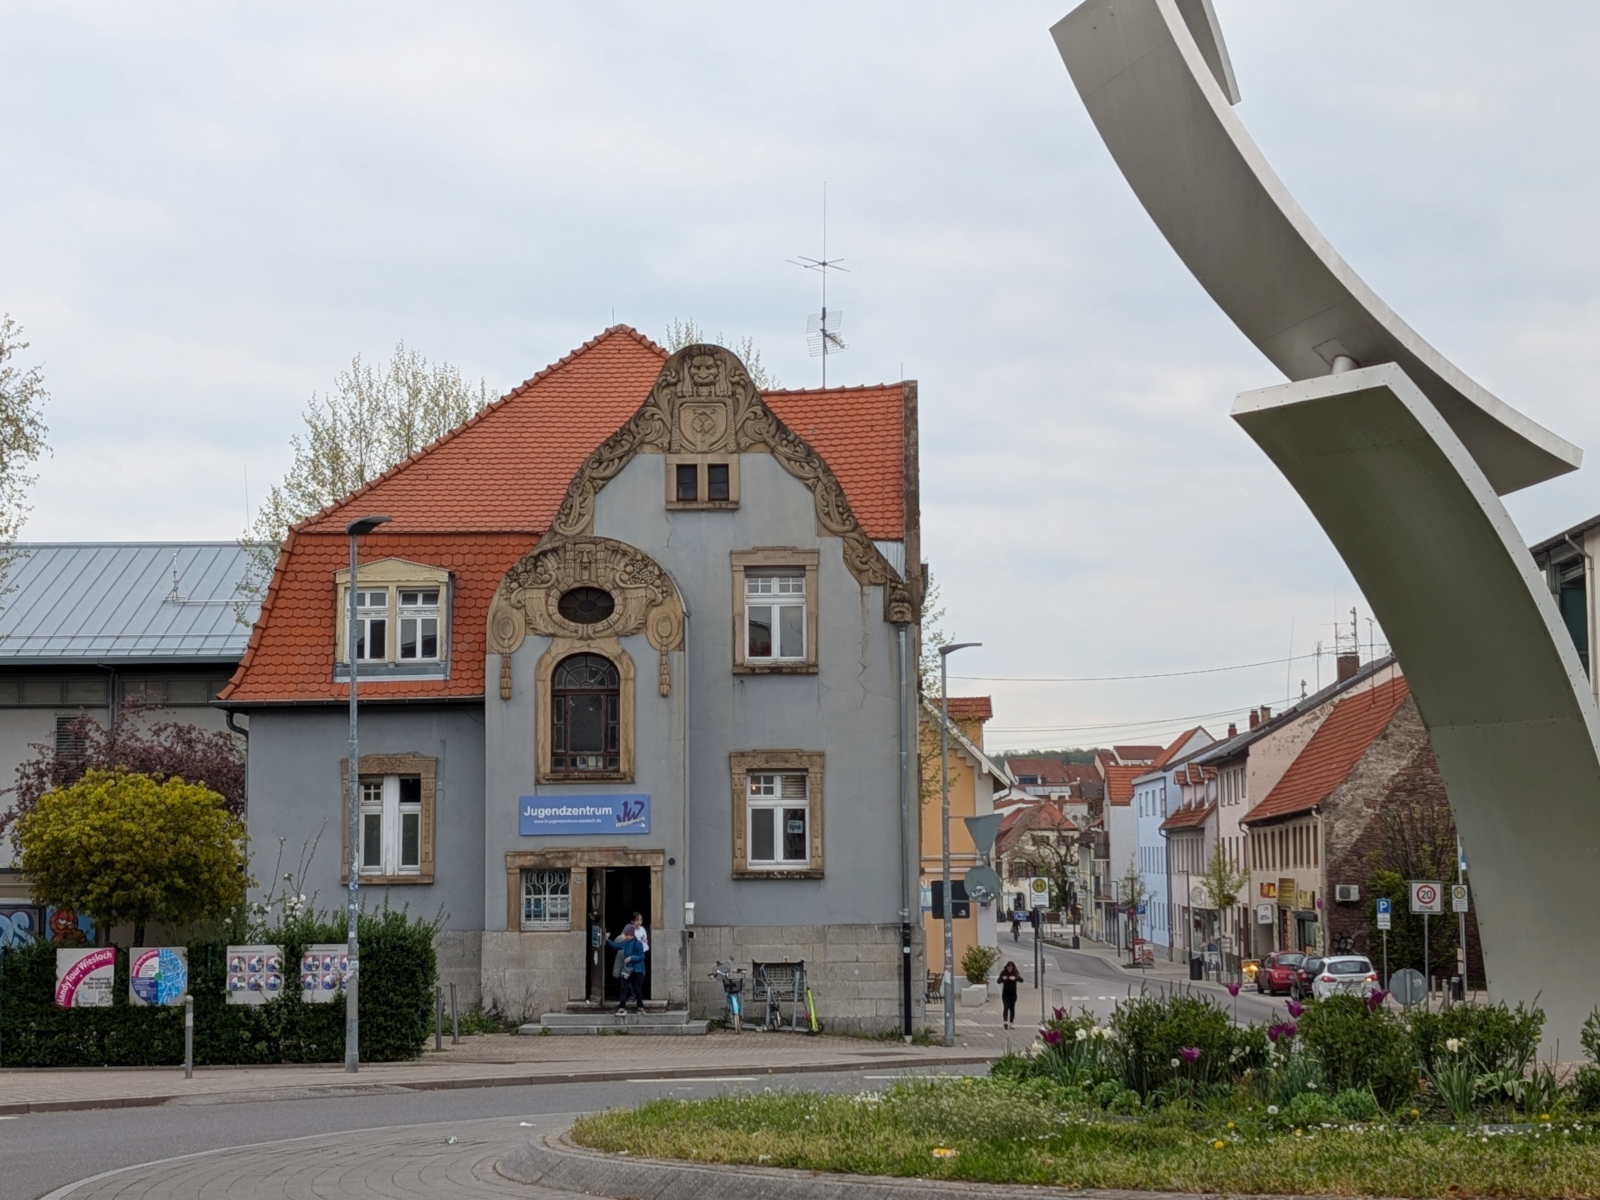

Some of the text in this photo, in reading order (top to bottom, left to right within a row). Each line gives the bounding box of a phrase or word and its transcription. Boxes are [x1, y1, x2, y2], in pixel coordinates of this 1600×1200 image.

[523, 805, 613, 818] Jugendzentrum
[1420, 890, 1433, 899] 20
[1379, 900, 1388, 911] P
[65, 966, 81, 982] Tour
[77, 950, 113, 970] Wiesloch
